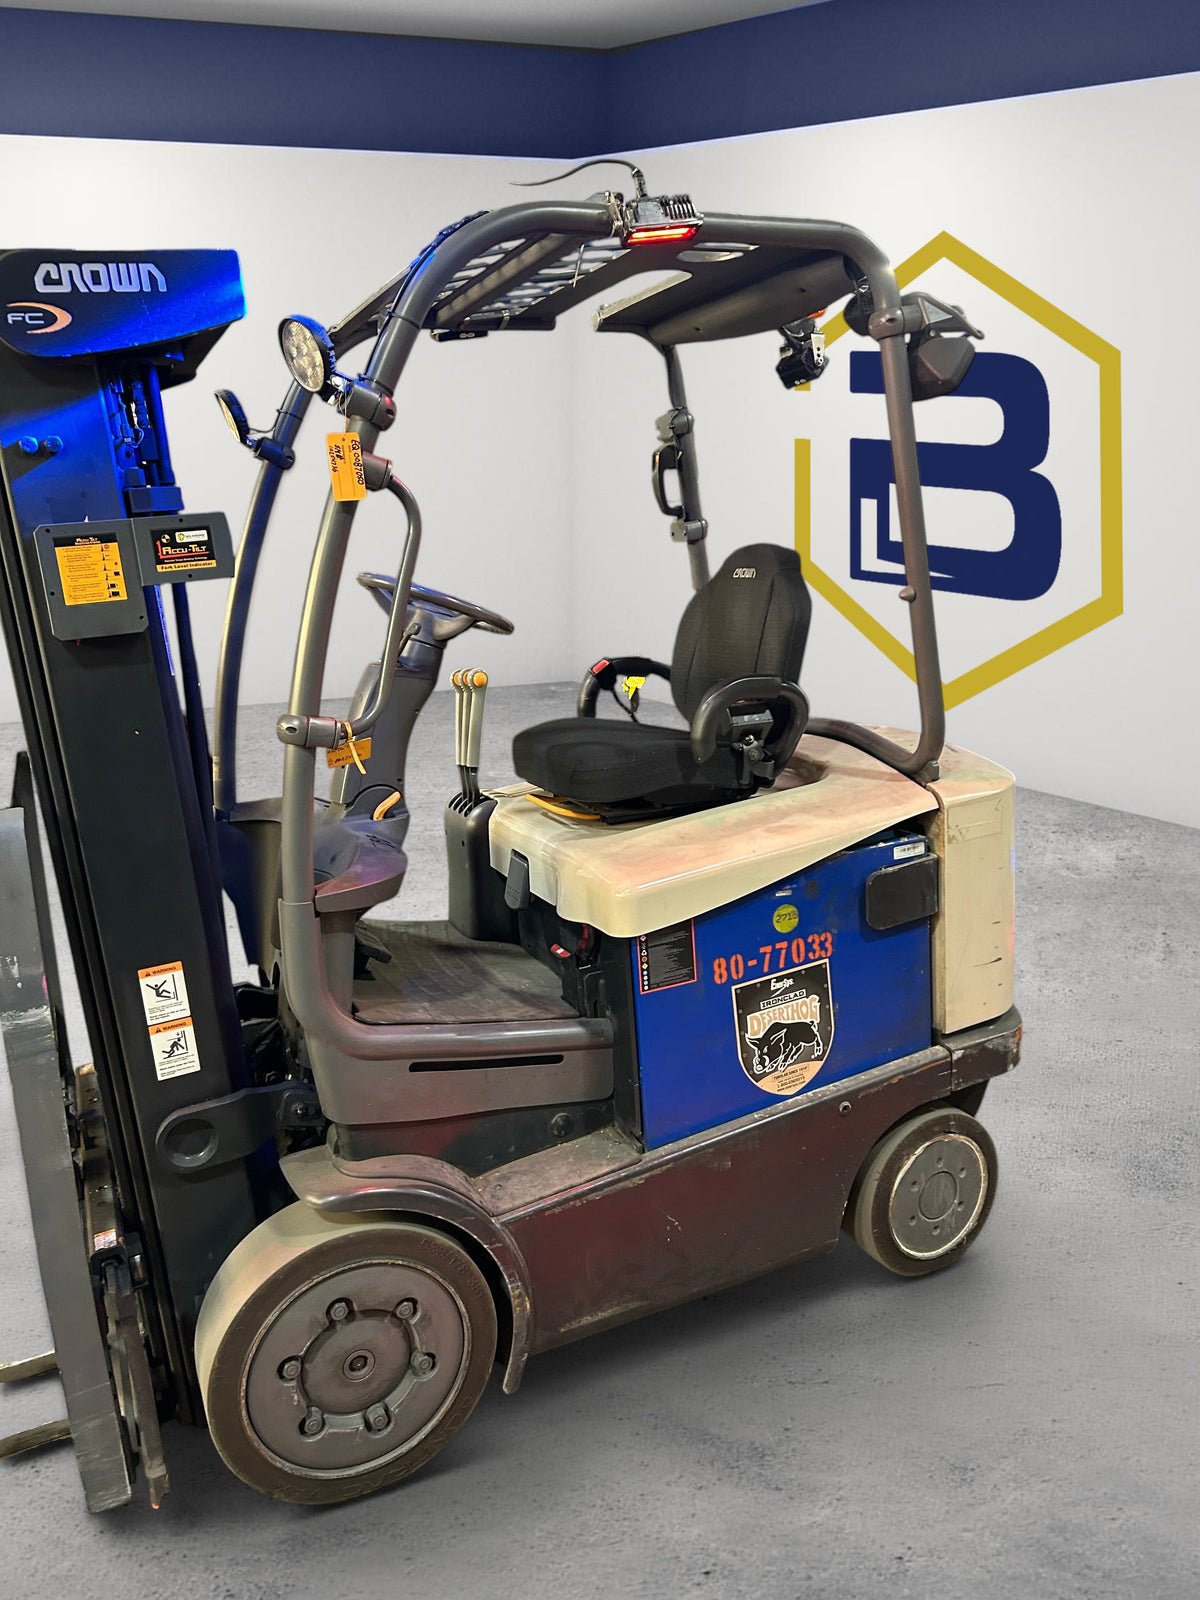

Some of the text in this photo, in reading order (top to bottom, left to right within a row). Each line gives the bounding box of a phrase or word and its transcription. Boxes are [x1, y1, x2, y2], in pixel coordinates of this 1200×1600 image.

[34, 263, 167, 293] CROWN
[7, 312, 45, 324] FC
[713, 932, 833, 984] 80-77033
[152, 966, 177, 975] WARNING
[761, 990, 806, 1008] IRONCLAD
[747, 995, 820, 1038] DESERTHOG
[163, 1022, 187, 1031] WARNING
